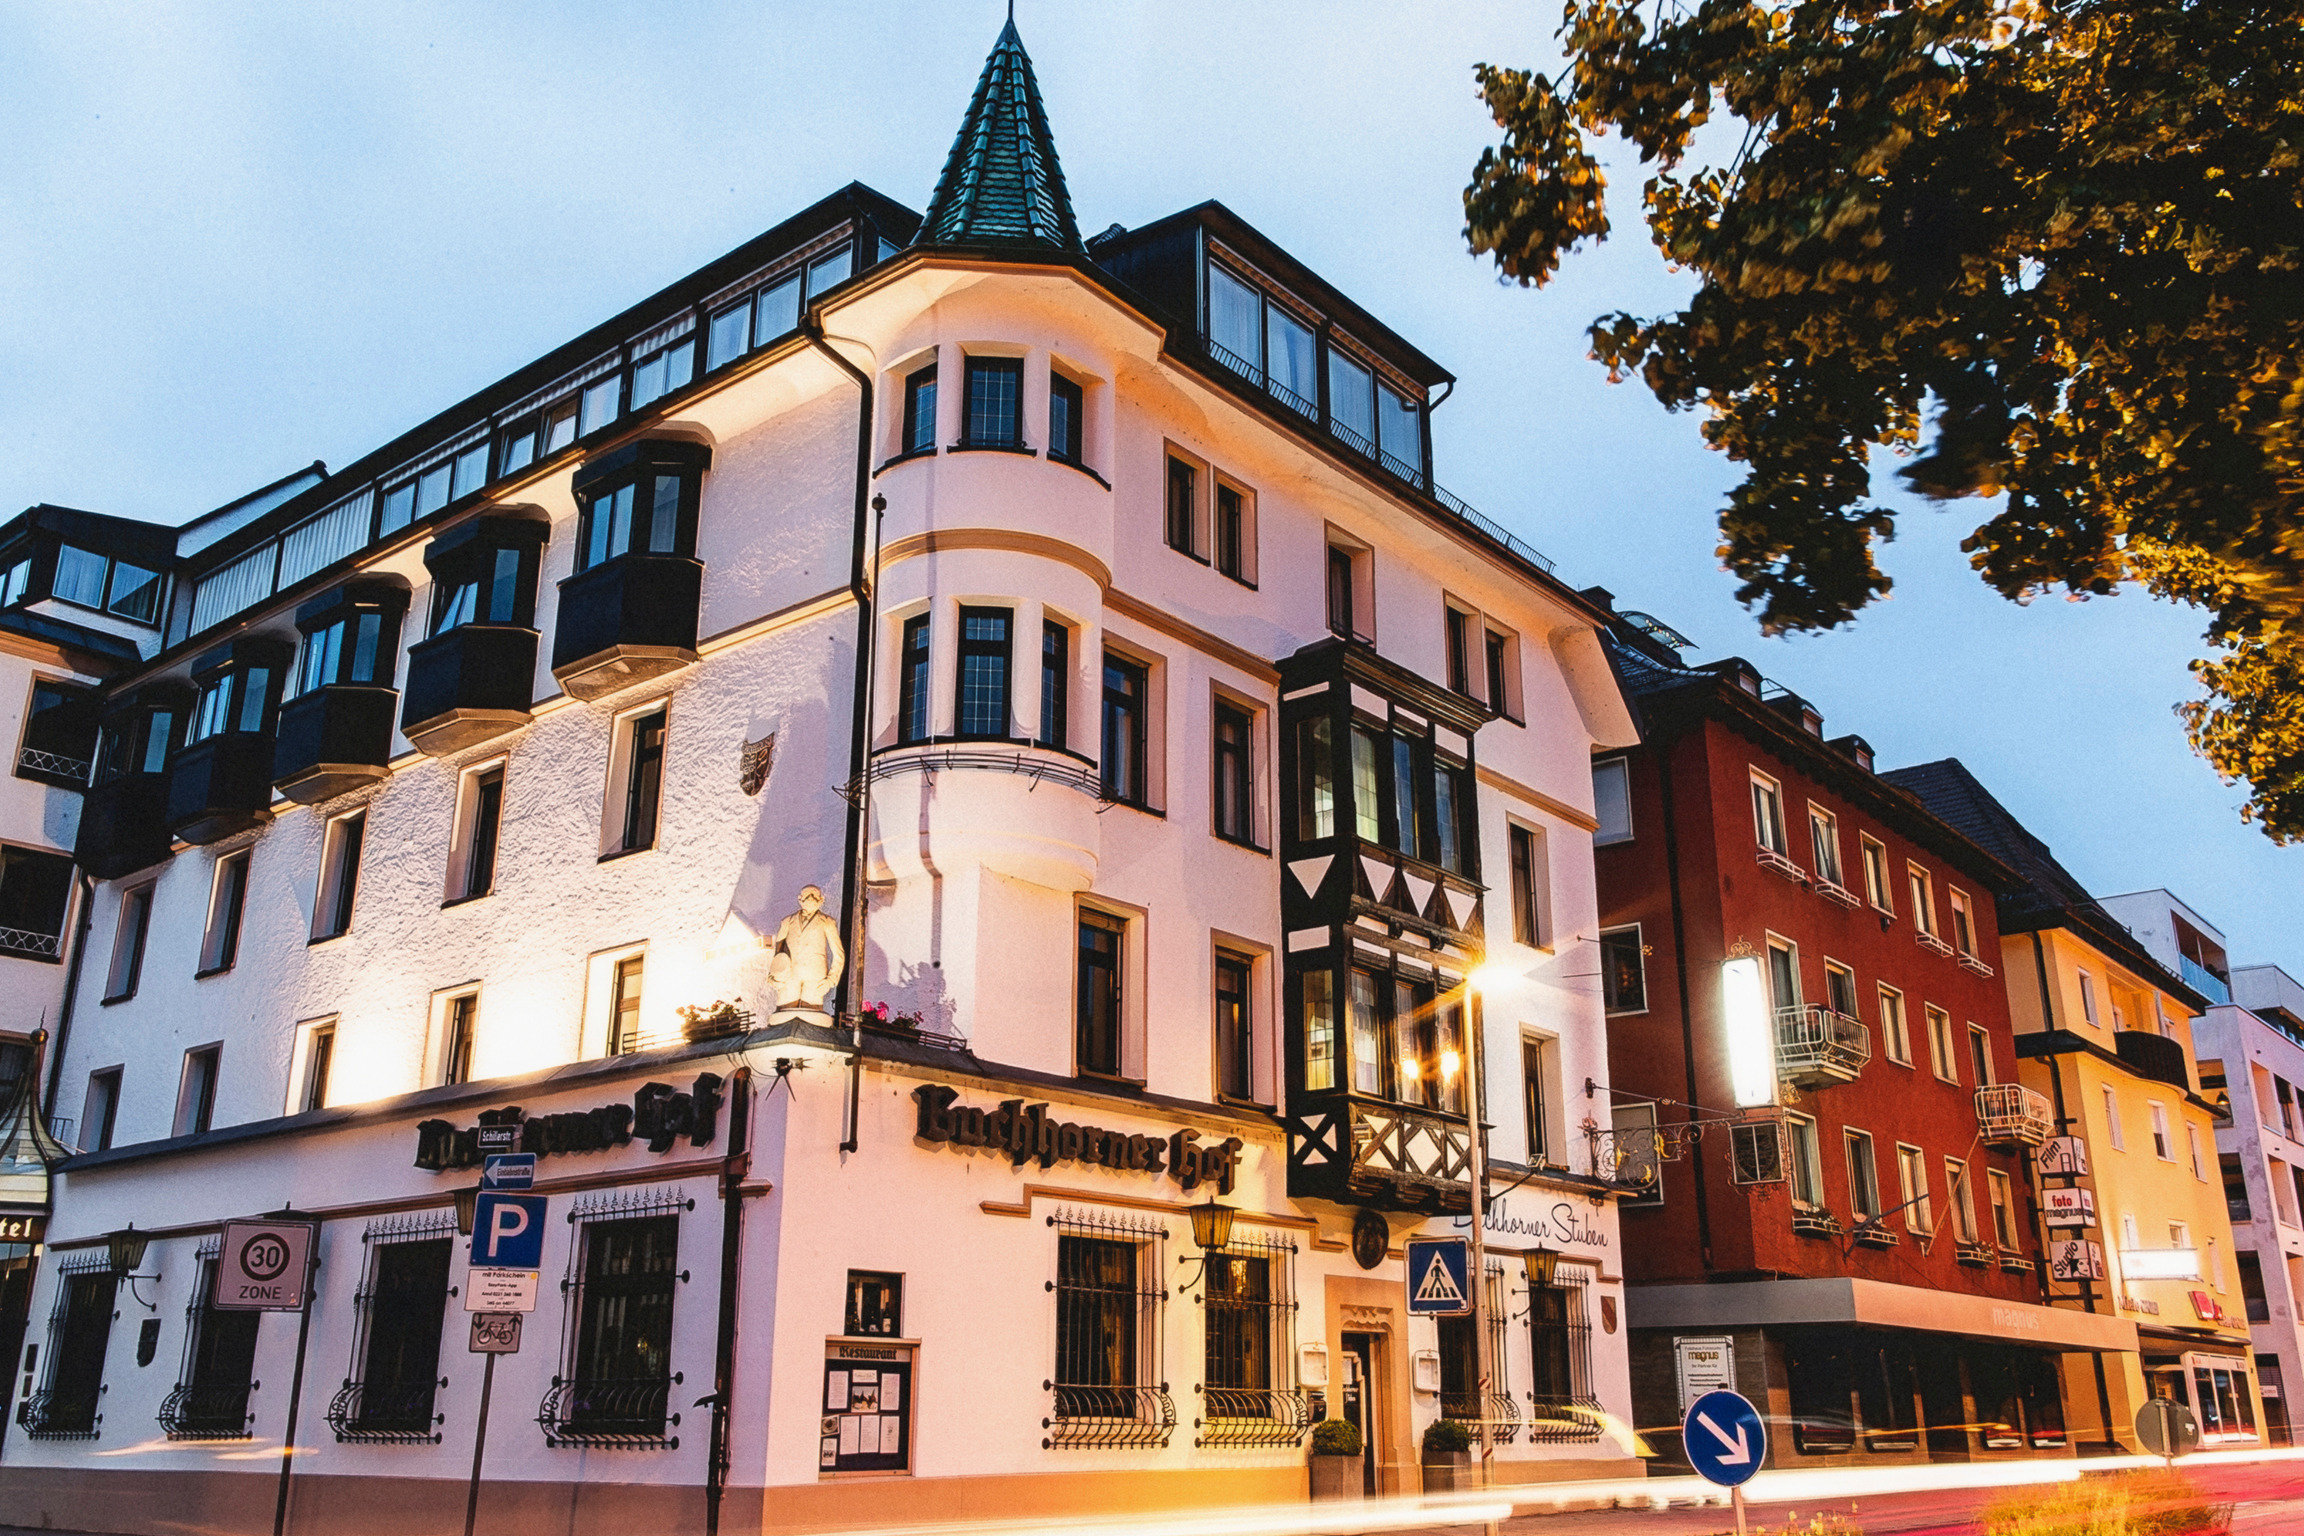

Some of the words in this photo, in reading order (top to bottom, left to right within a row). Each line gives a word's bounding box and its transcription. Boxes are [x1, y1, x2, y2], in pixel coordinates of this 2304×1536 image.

[912, 1085, 1167, 1173] Buchhorner
[1168, 1128, 1243, 1195] Hof
[2040, 1140, 2061, 1169] Film
[2052, 1195, 2073, 1207] foto
[487, 1203, 529, 1257] P
[1551, 1203, 1608, 1247] Stuben
[250, 1245, 280, 1268] 30
[2053, 1241, 2079, 1277] Studio
[239, 1285, 282, 1300] ZONE
[1992, 1307, 2040, 1336] magnus
[838, 1345, 898, 1360] Restaurant
[1688, 1351, 1719, 1362] magnus
